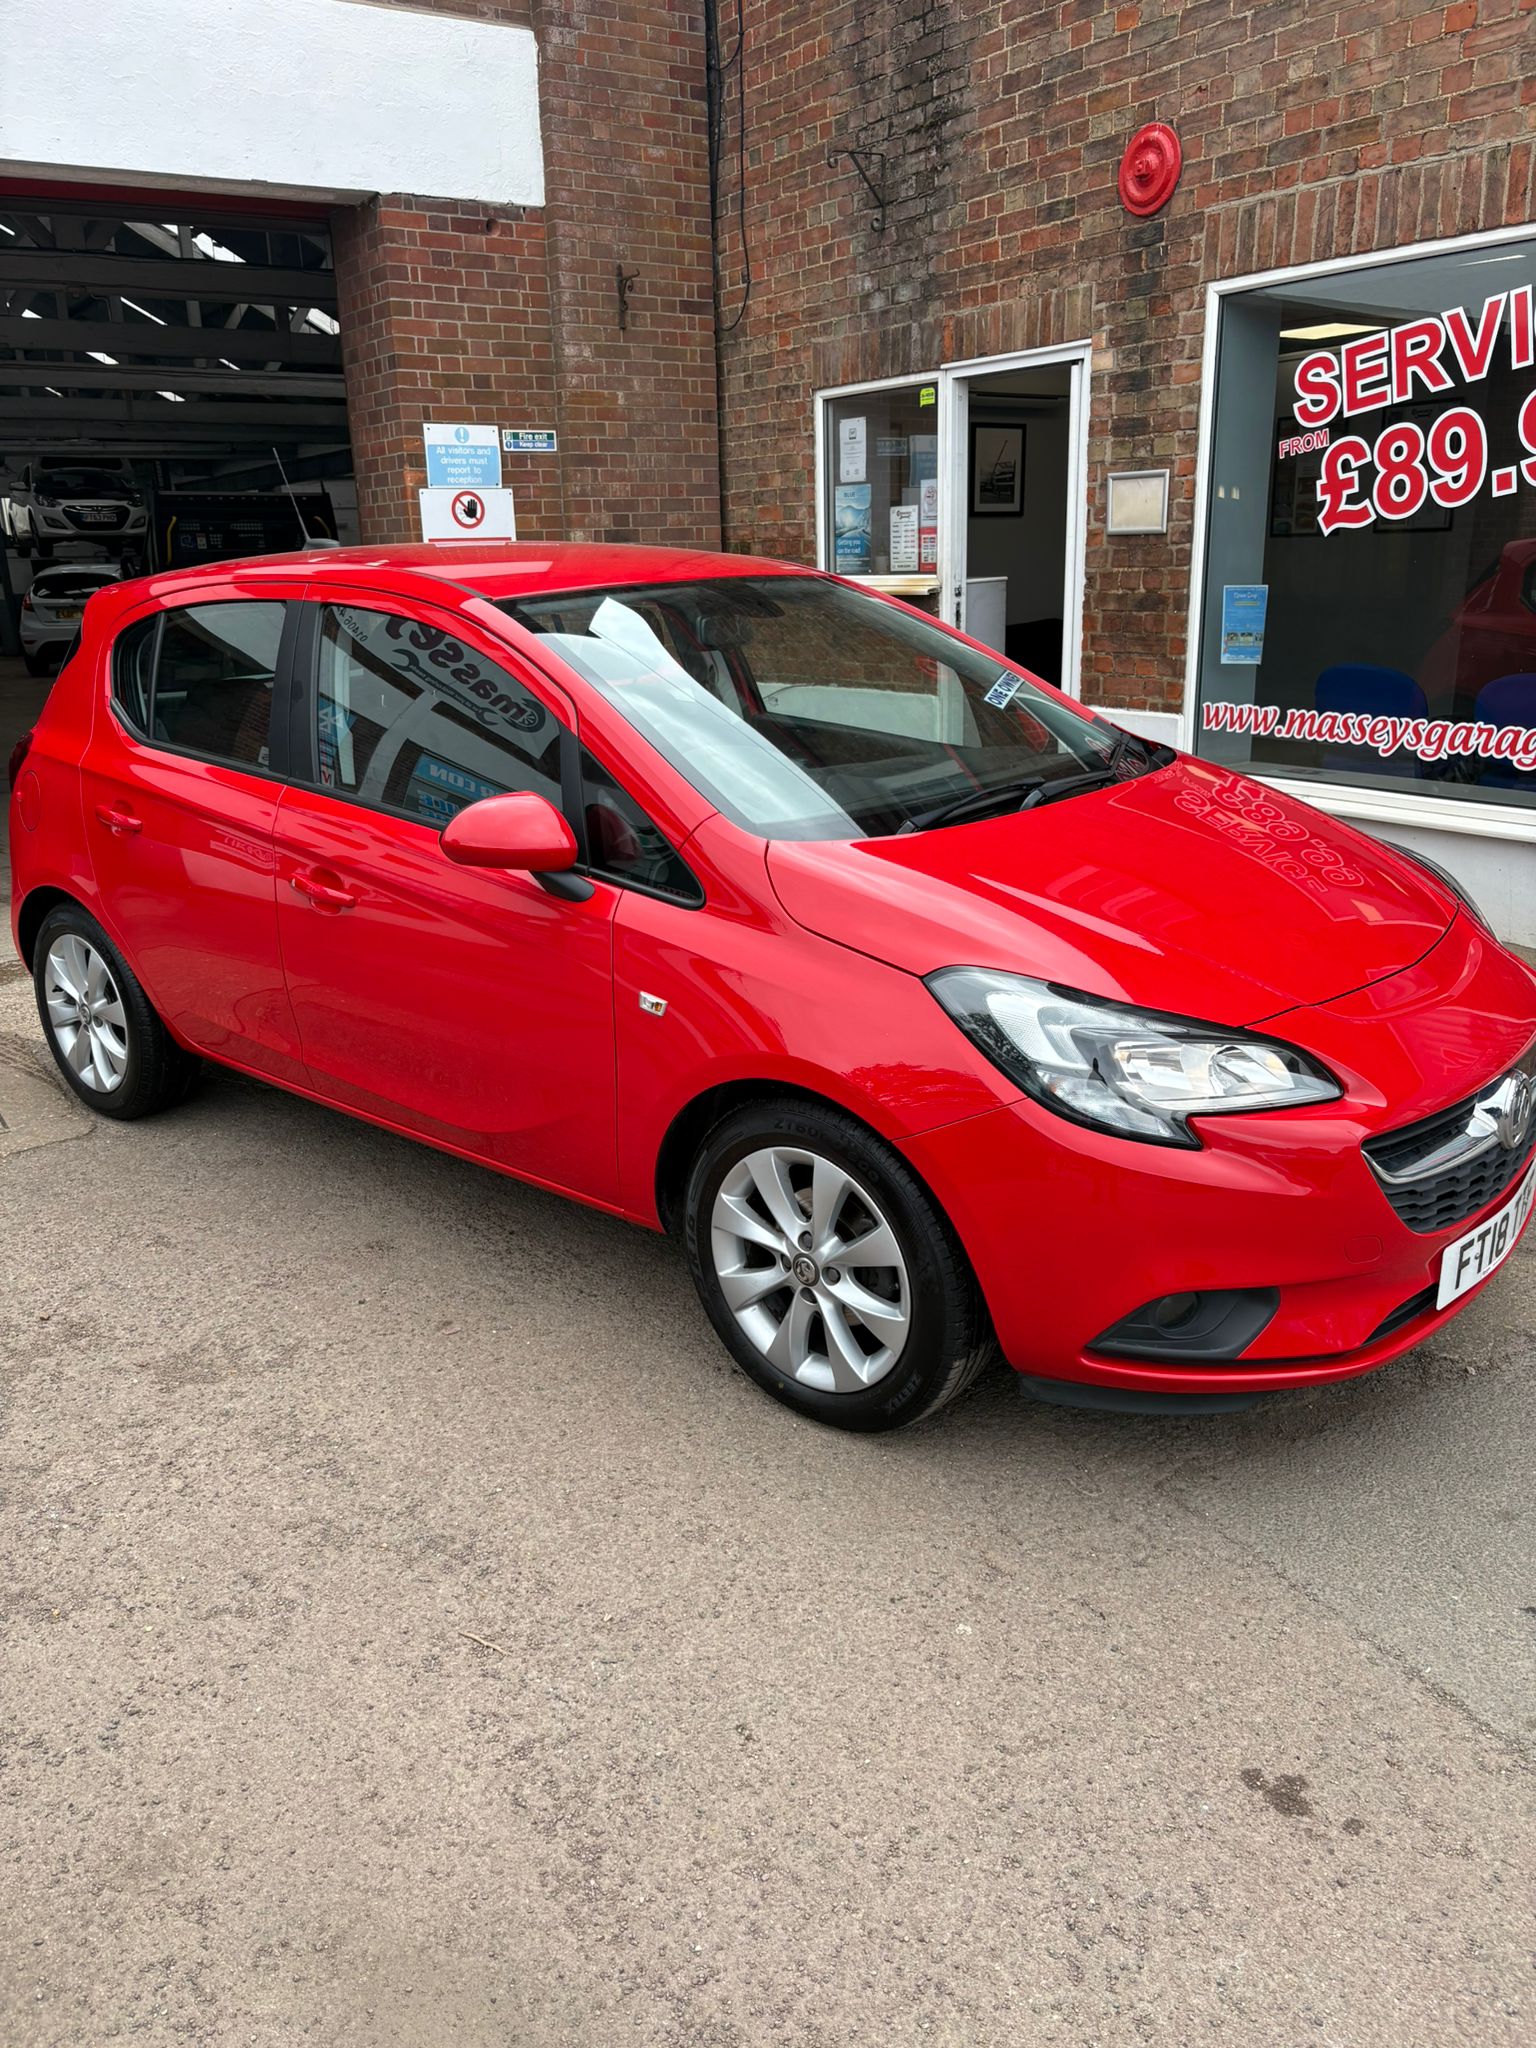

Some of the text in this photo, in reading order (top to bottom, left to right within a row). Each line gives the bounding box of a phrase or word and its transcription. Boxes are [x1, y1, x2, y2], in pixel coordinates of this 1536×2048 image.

[1293, 284, 1536, 428] SERVI
[519, 432, 548, 441] Fire exit
[1279, 428, 1330, 459] FROM
[436, 446, 491, 456] All visitors and
[440, 455, 488, 465] drivers must
[447, 466, 482, 476] report to
[447, 476, 483, 486] reception
[987, 688, 1009, 706] ONE
[1455, 1211, 1510, 1290] FT18
